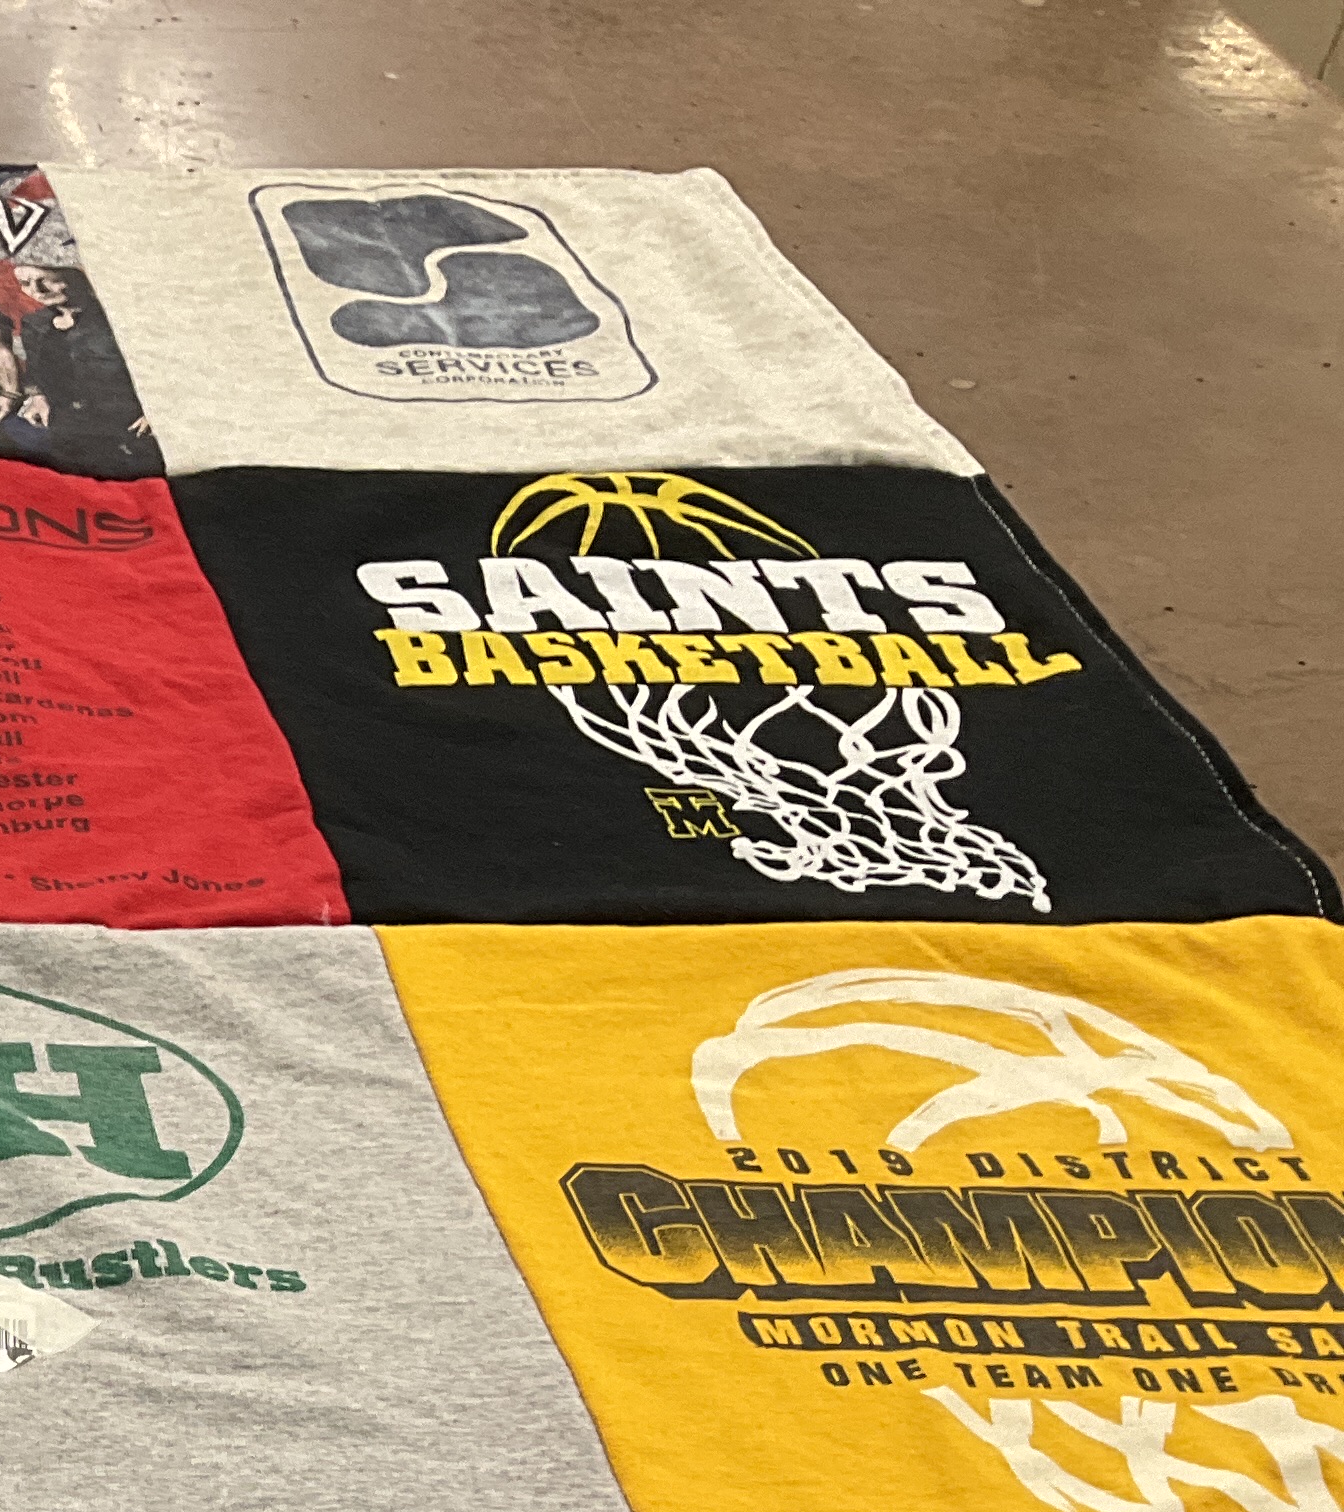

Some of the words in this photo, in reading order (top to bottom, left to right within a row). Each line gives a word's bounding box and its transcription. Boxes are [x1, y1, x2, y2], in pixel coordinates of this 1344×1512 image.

[376, 358, 600, 379] SERVICES
[422, 376, 566, 387] CORPORATION
[355, 556, 1006, 635] SAINTS
[374, 628, 1084, 688] BASKETBALL
[162, 867, 267, 893] Jones
[726, 1147, 915, 1176] 2019
[976, 1151, 1311, 1182] DISTRICT
[754, 1316, 1021, 1350] MORMON
[1063, 1320, 1238, 1352] TRAIL
[823, 1359, 928, 1388] ONE
[960, 1361, 1104, 1389] TEAM
[1136, 1365, 1239, 1393] ONE
